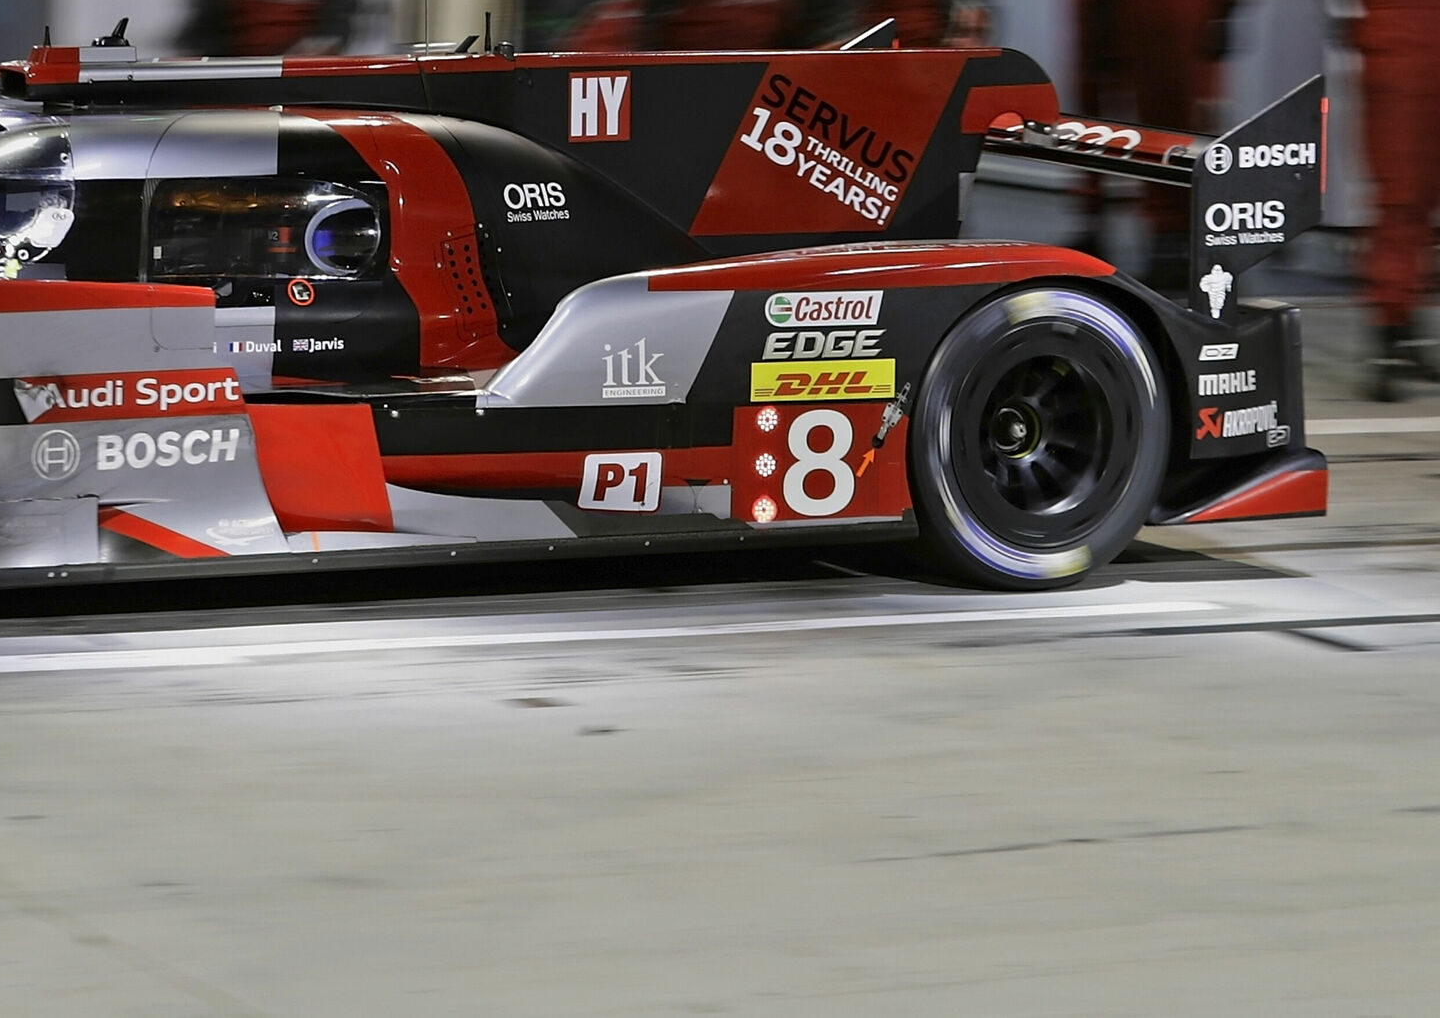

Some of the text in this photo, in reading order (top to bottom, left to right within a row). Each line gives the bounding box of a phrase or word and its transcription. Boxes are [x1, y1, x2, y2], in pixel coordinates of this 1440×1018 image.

[570, 76, 628, 137] HY
[761, 73, 914, 184] SERVUS
[740, 107, 899, 202] 18 THRILLING
[1238, 143, 1316, 169] BOSCH
[503, 182, 566, 210] ORIS
[796, 152, 891, 225] YEARS!
[507, 208, 570, 223] Swiss Watches
[1204, 200, 1286, 232] ORIS
[1205, 232, 1285, 247] Swiss Watches
[794, 295, 875, 323] Castrol
[245, 337, 345, 353] Duval Jarvis
[762, 329, 887, 360] EDGE
[602, 337, 666, 386] itk
[135, 377, 240, 411] Sport
[604, 387, 665, 397] ENGINEERING
[773, 371, 874, 397] DHL
[1198, 369, 1256, 396] MAHLE
[97, 429, 240, 471] BOSCH
[783, 409, 855, 516] 8
[592, 462, 649, 503] P1
